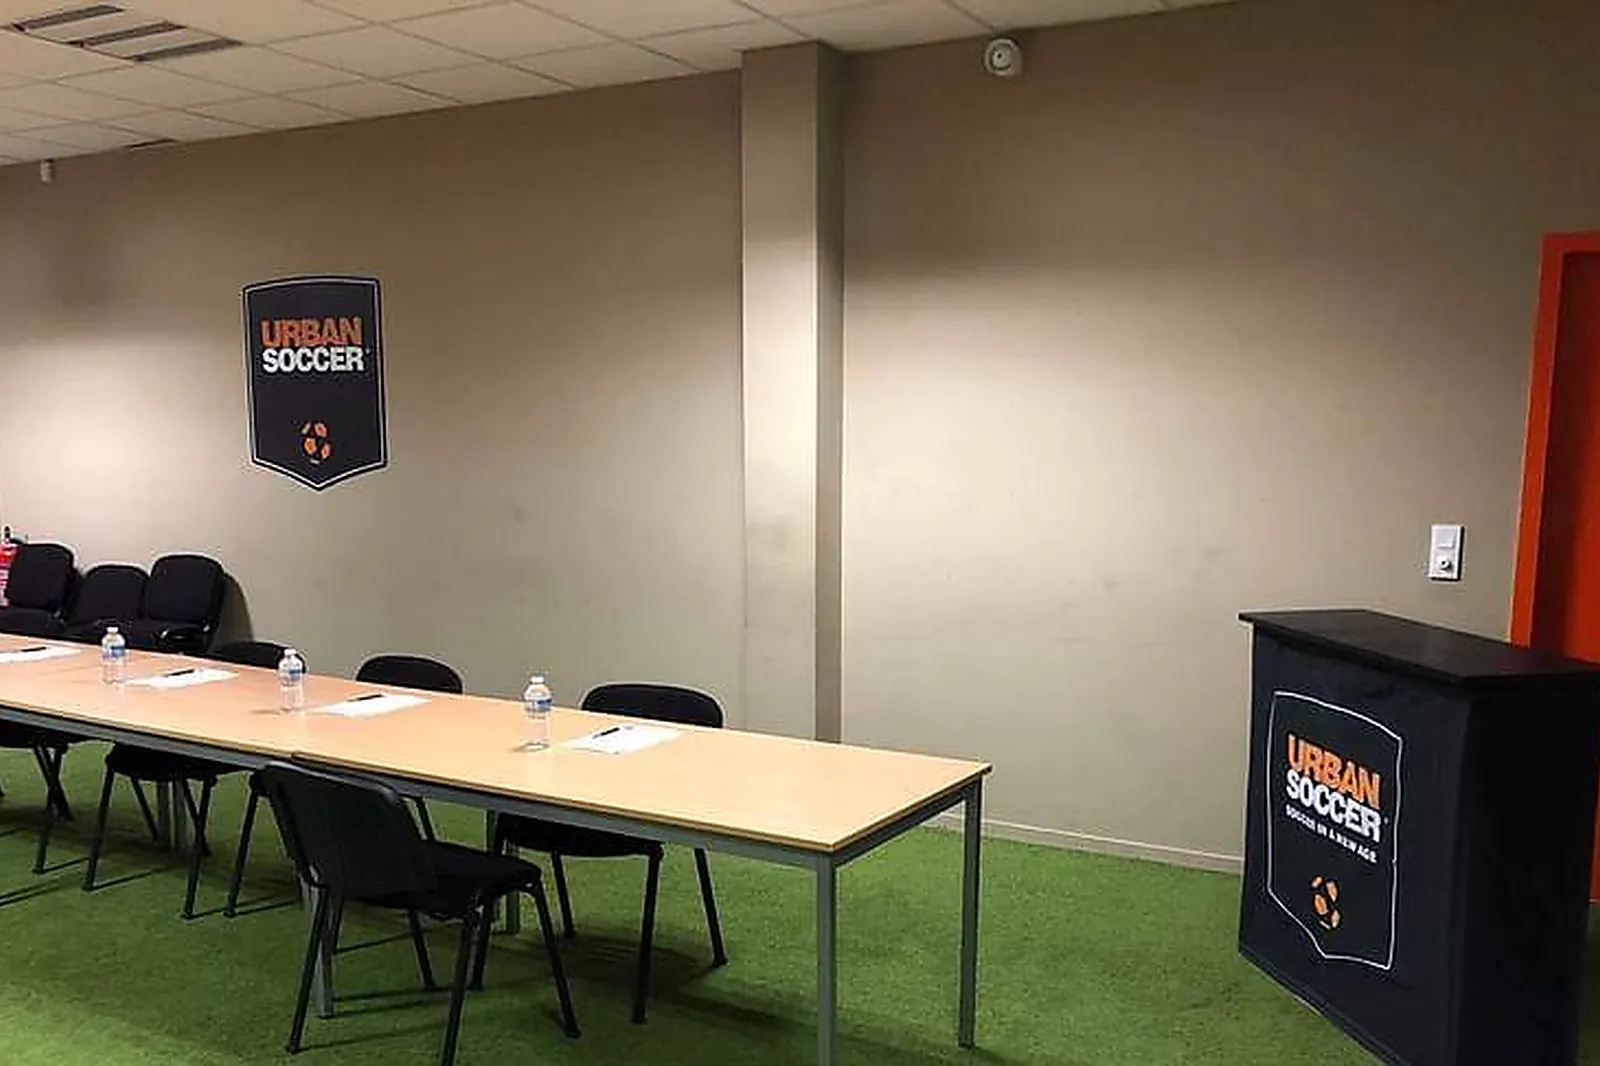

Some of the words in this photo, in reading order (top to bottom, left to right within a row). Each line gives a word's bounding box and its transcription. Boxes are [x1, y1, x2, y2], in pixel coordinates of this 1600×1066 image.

[261, 317, 363, 347] URBAN
[262, 346, 364, 373] SOCCER
[1287, 734, 1381, 809] URBAN
[1286, 769, 1382, 843] SOCCER
